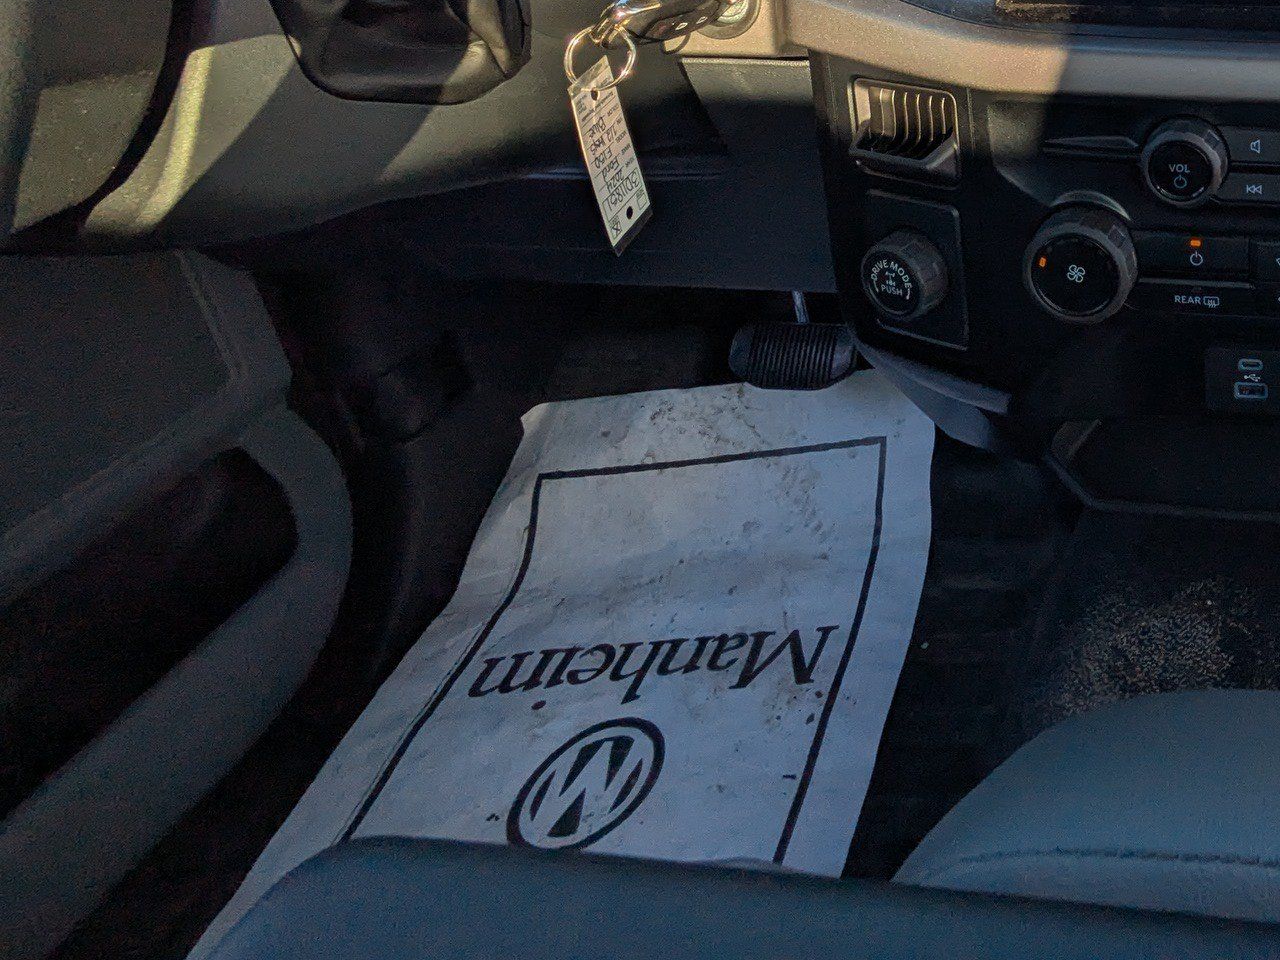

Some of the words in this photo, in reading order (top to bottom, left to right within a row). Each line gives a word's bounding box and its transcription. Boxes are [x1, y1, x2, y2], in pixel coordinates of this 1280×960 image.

[593, 144, 613, 171] F150
[600, 154, 620, 182] Ford
[1168, 163, 1190, 173] VOL
[870, 259, 889, 281] DRIVE
[889, 261, 913, 289] MODE
[881, 284, 903, 296] PUSH
[1174, 295, 1201, 305] REAR
[468, 624, 840, 711] Manheim
